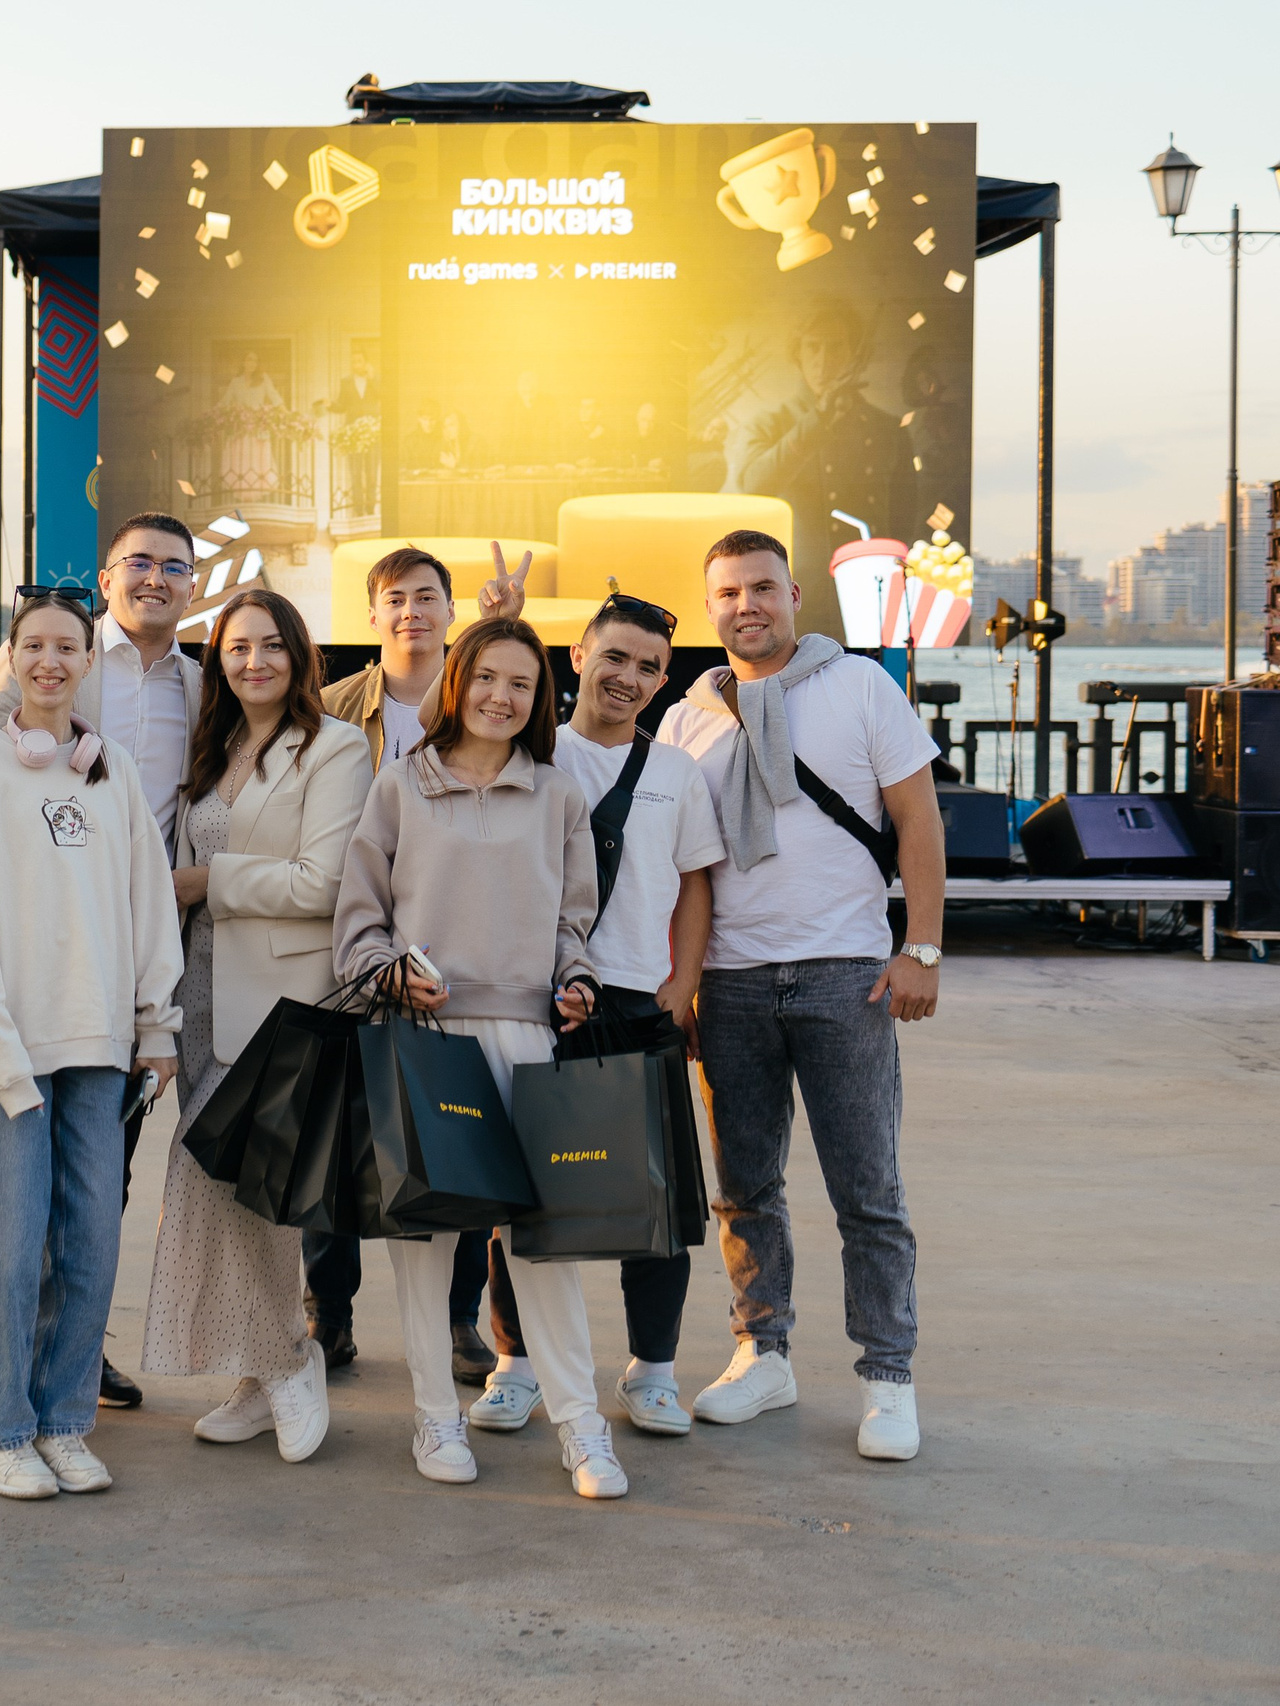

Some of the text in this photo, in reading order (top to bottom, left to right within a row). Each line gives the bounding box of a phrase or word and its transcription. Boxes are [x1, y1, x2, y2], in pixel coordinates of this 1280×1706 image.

[460, 171, 625, 205] БОЛЬШОЙ
[452, 207, 634, 235] КИНОКВИЗ
[462, 262, 538, 285] games
[589, 262, 677, 279] PREMIER
[448, 1103, 483, 1119] PREMIER
[561, 1150, 608, 1163] PREMIER
